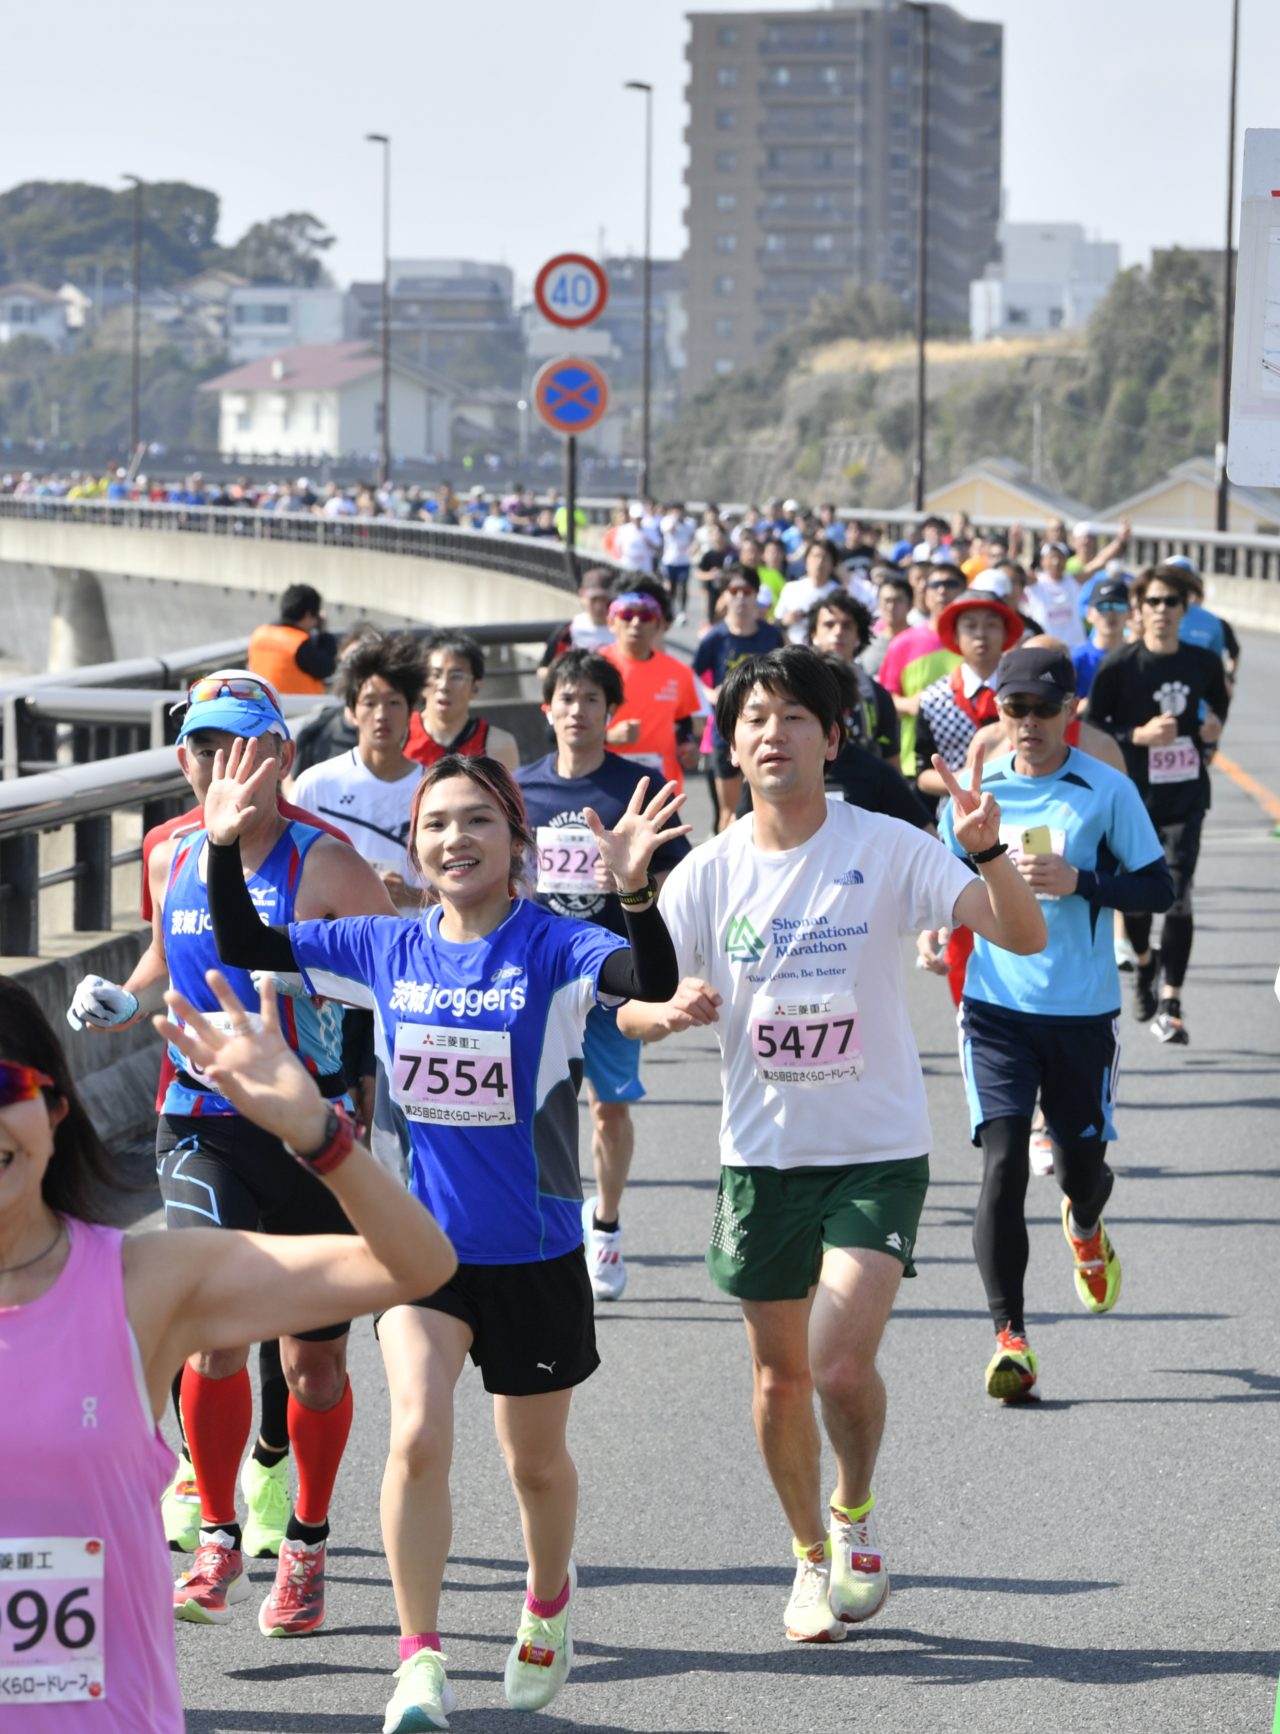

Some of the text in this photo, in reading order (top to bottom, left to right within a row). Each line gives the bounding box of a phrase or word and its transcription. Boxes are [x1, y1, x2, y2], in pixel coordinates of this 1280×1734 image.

[550, 273, 593, 308] 40
[1153, 748, 1197, 771] 5912
[771, 915, 828, 931] Shonan
[772, 921, 869, 945] International
[775, 941, 847, 959] Marathon
[800, 968, 814, 978] Be
[816, 967, 847, 977] Better
[389, 979, 526, 1018] 茨城joggers
[787, 1002, 832, 1016] 三菱重工
[436, 1034, 481, 1051] 三菱重工
[758, 1018, 855, 1060] 5477
[399, 1054, 509, 1098] 7554
